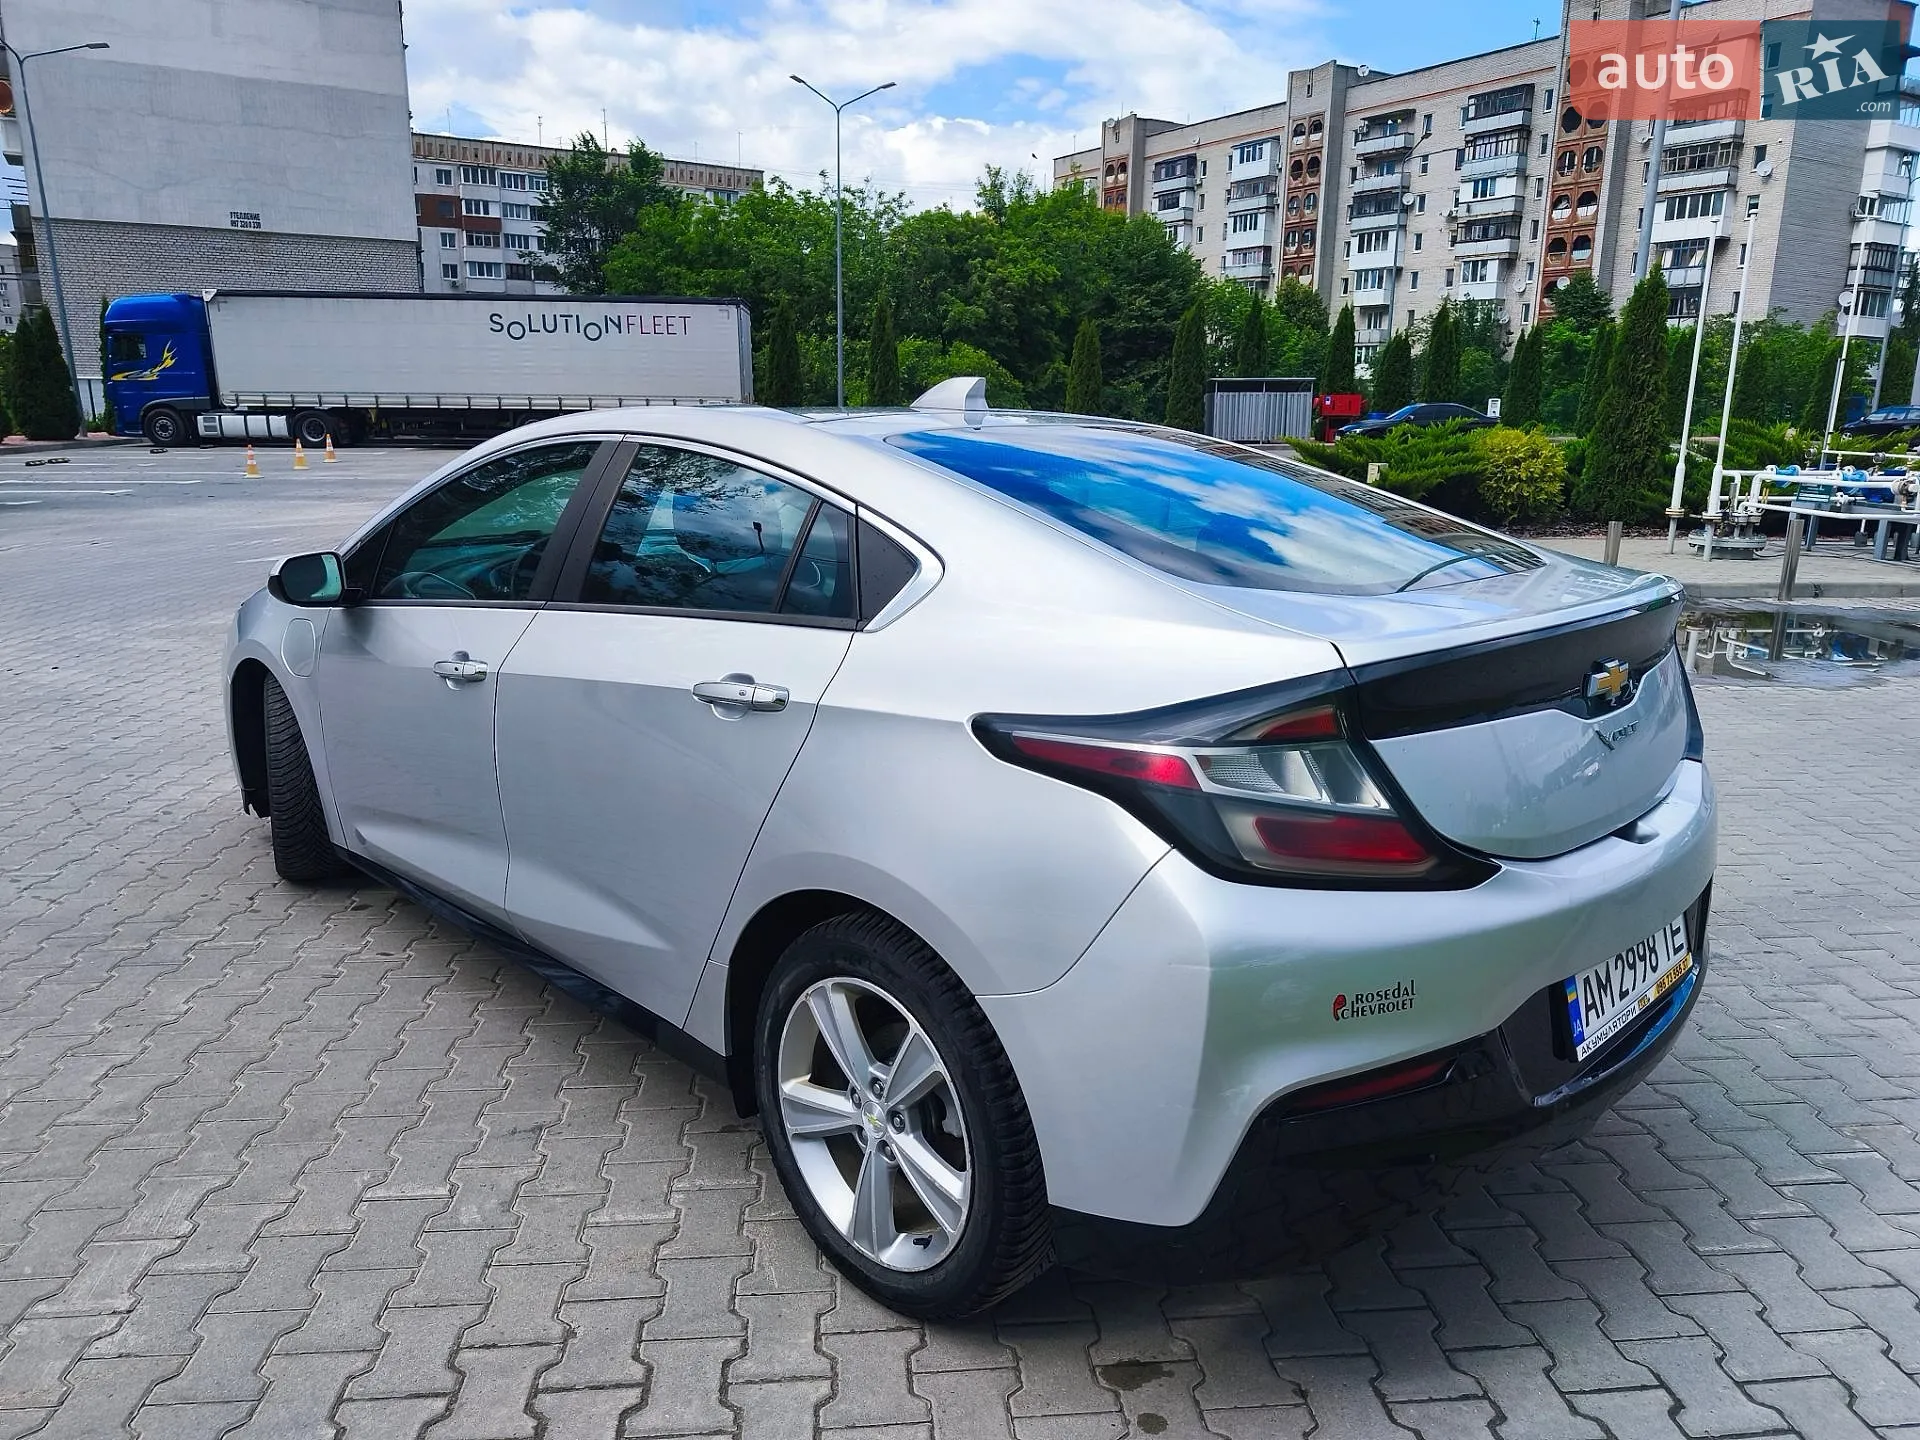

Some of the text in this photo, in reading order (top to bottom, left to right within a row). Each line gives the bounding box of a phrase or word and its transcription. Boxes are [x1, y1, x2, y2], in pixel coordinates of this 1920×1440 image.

[1583, 922, 1685, 1028] AM 2998 IE
[1581, 1005, 1637, 1058] АКУМУЛЯТОРИ
